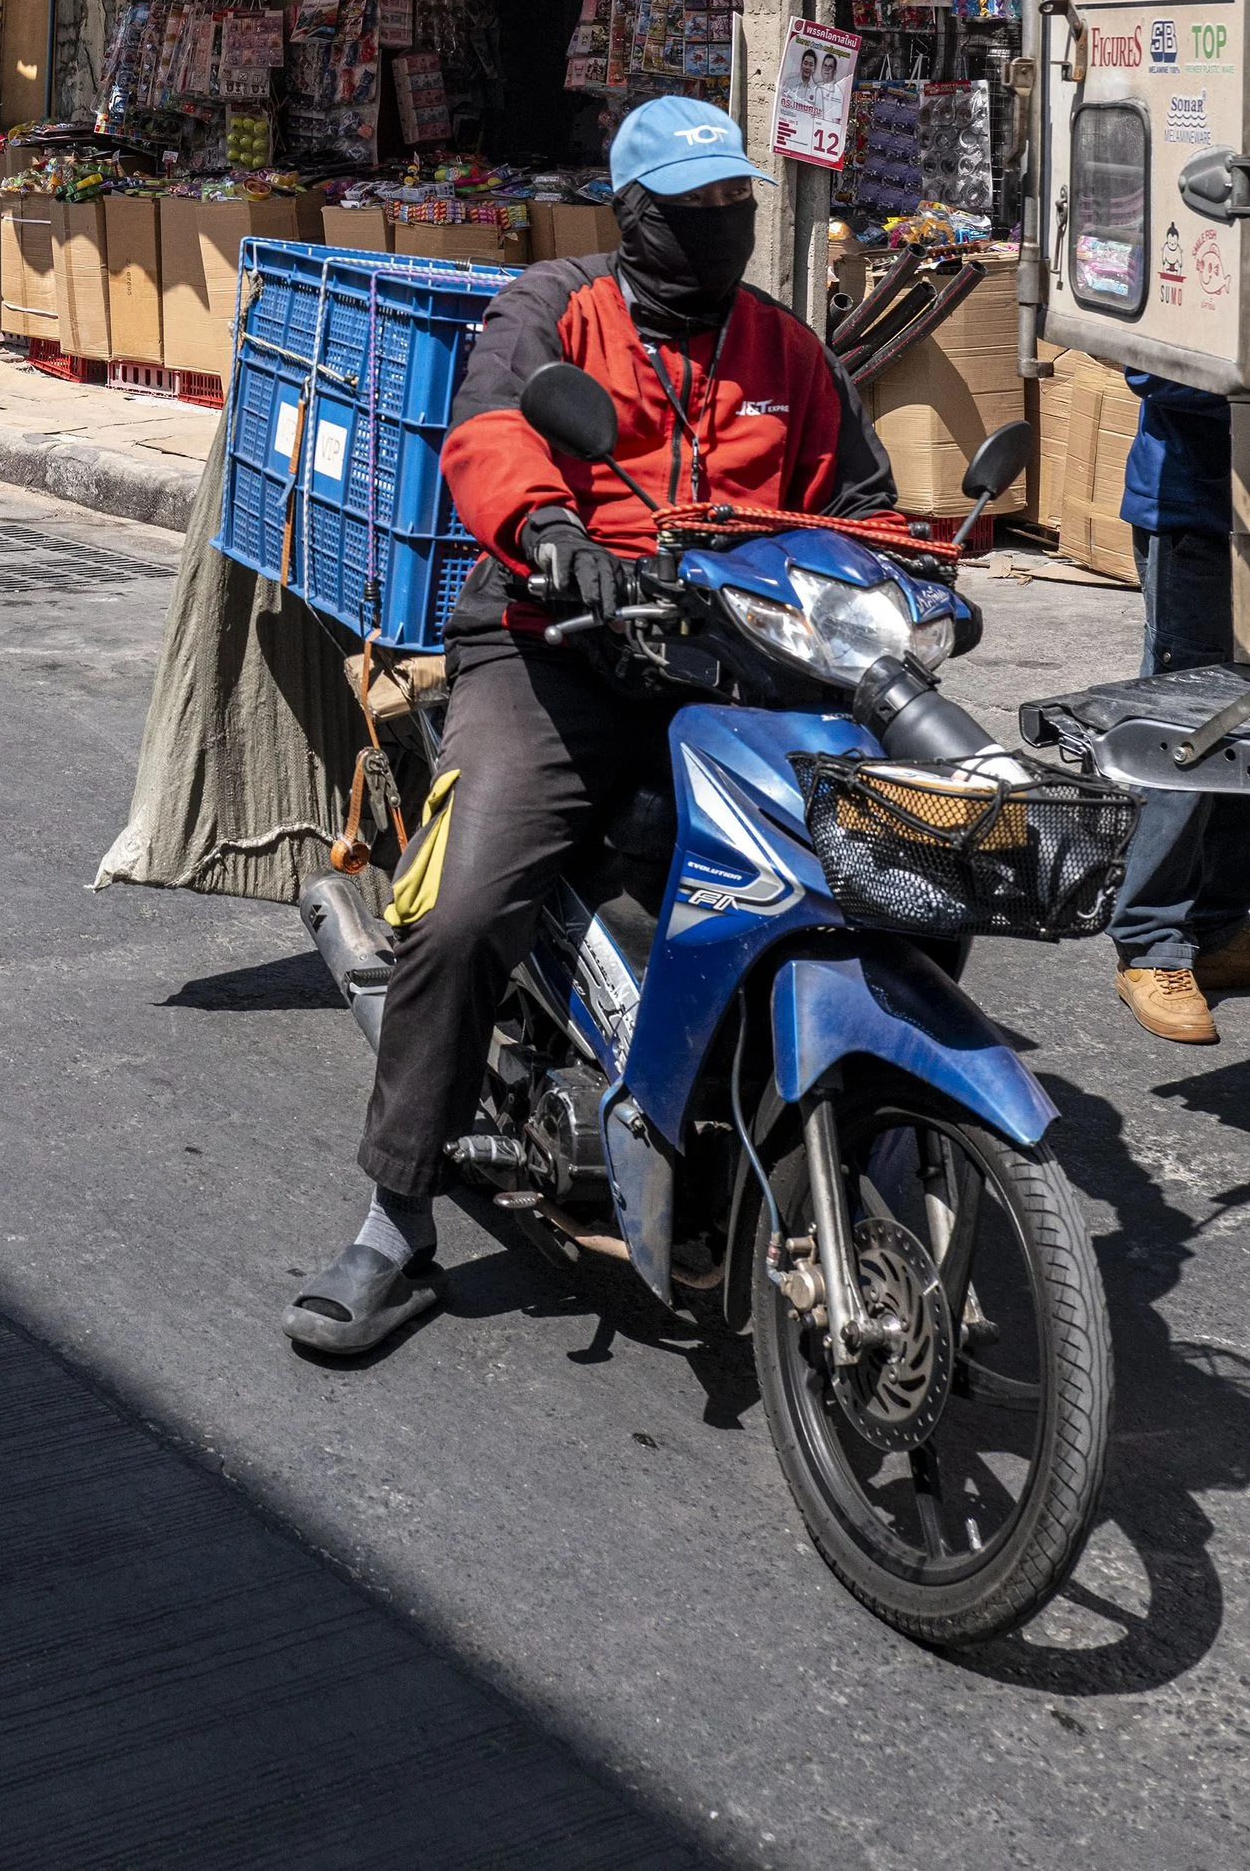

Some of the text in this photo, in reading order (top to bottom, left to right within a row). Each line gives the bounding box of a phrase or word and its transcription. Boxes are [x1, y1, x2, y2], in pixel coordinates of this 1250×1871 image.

[1091, 20, 1227, 68] FIGURES SB TOP
[813, 128, 840, 156] 12
[1160, 284, 1183, 306] SUMO
[735, 399, 790, 416] J&T EXPRE
[687, 860, 743, 881] EVOLUTION
